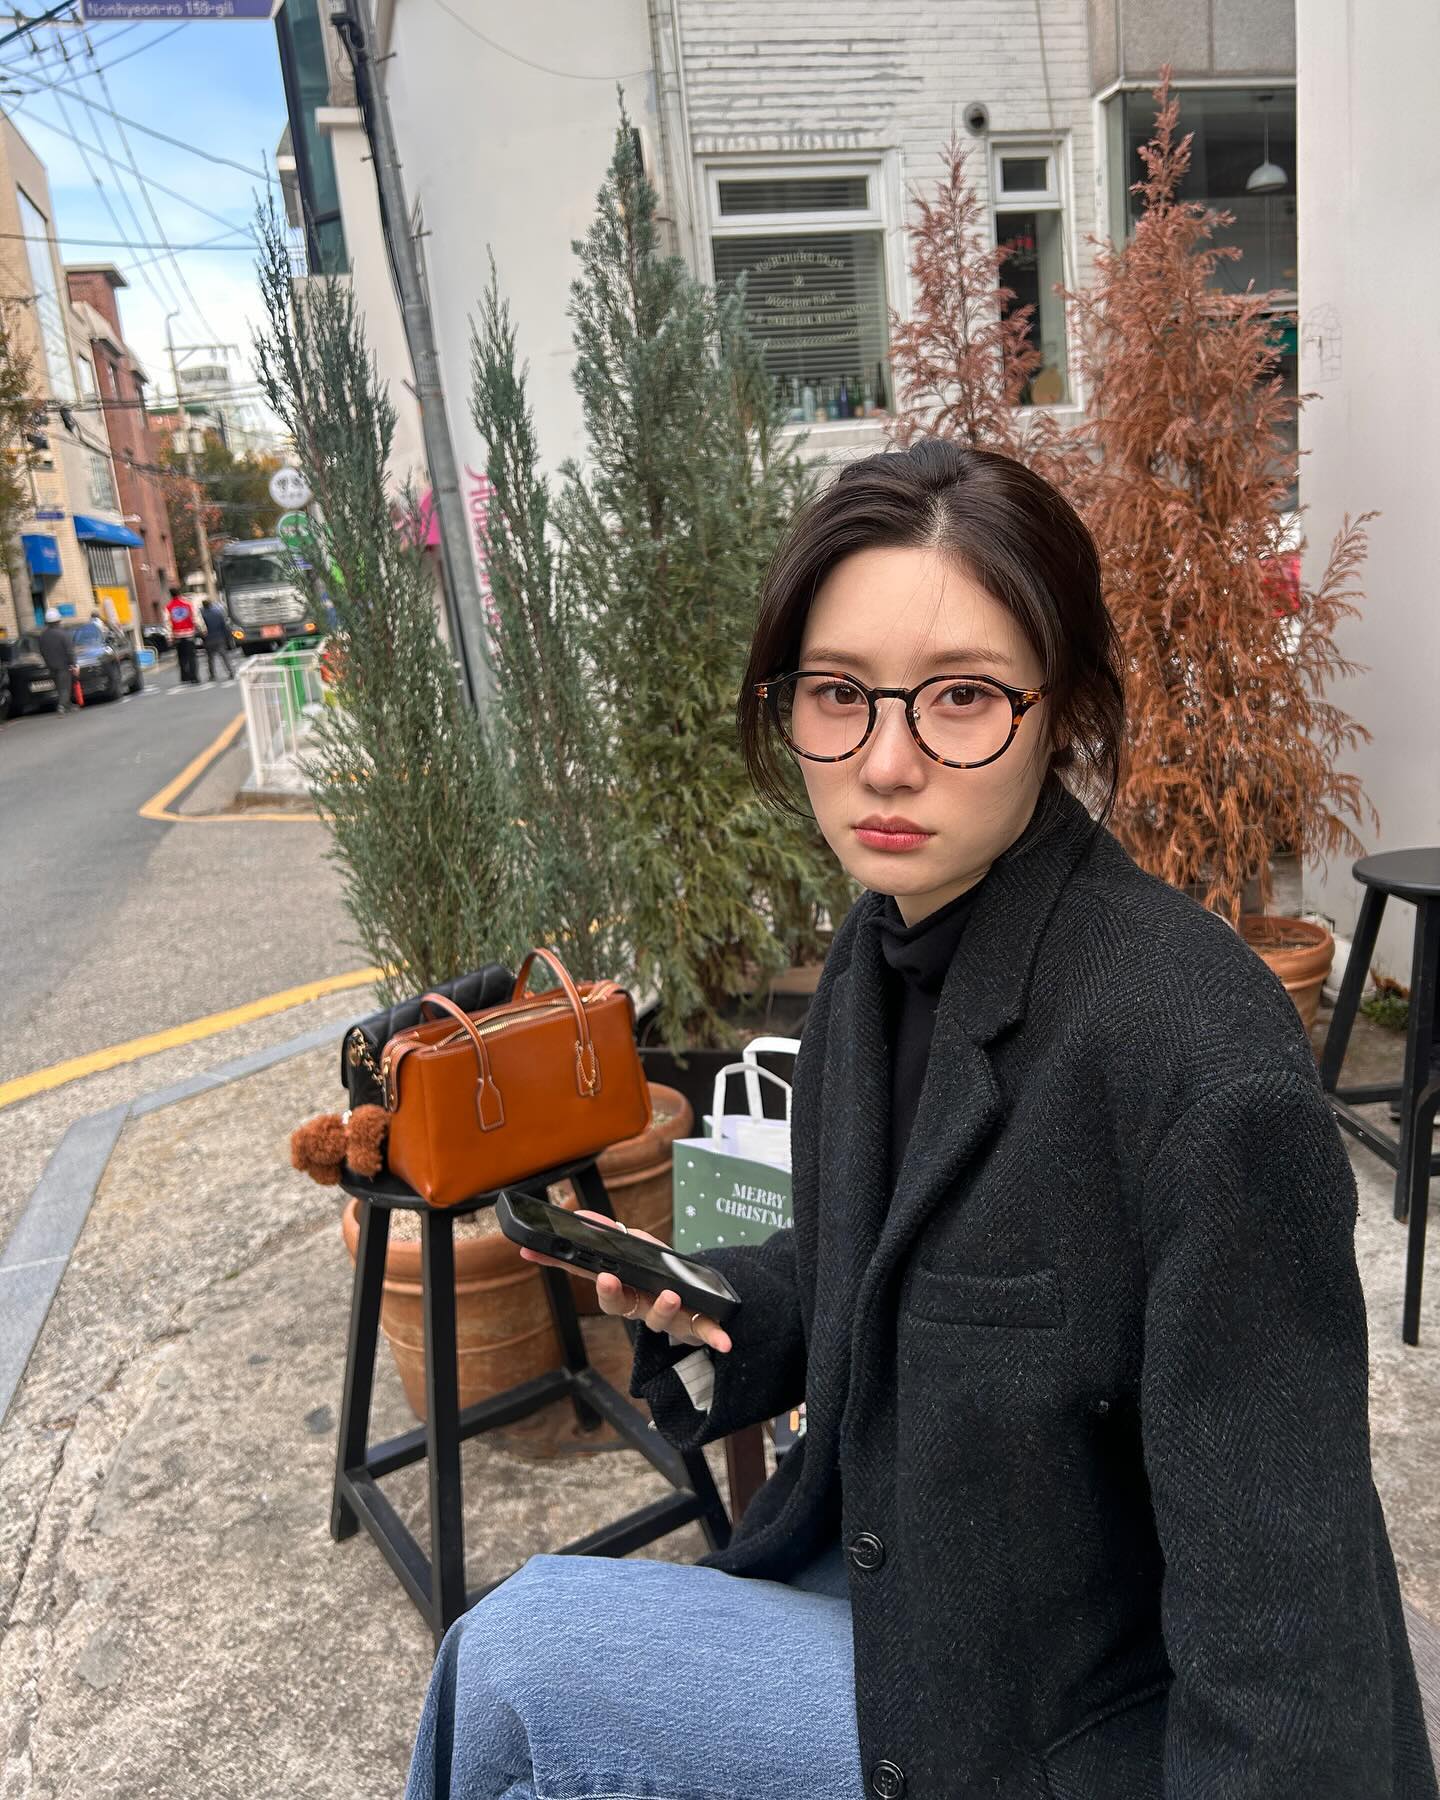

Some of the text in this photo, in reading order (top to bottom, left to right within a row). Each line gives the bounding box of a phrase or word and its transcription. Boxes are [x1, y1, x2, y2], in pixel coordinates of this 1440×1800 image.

[86, 3, 183, 17] Nonhyeon-ro
[732, 1183, 786, 1209] MERRY
[716, 1198, 794, 1229] CHRISTMA
